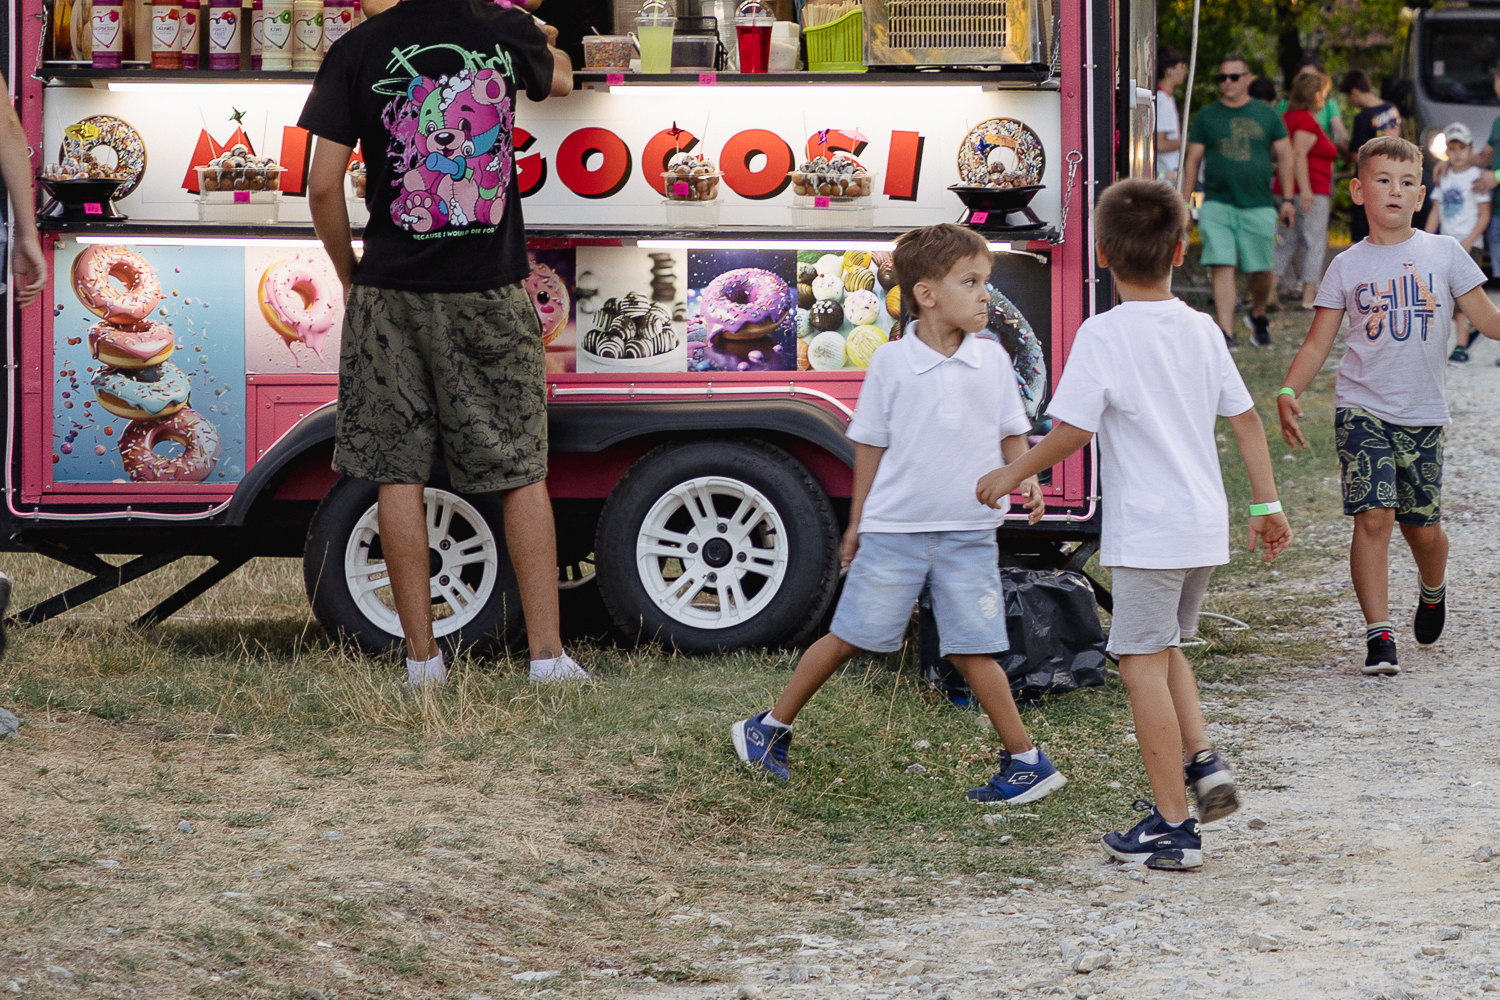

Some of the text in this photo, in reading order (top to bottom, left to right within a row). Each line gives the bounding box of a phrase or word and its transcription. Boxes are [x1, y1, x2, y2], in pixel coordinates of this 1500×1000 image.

[412, 231, 442, 240] BECAUSE
[447, 229, 469, 237] WOULD
[1362, 309, 1434, 344] OUT
